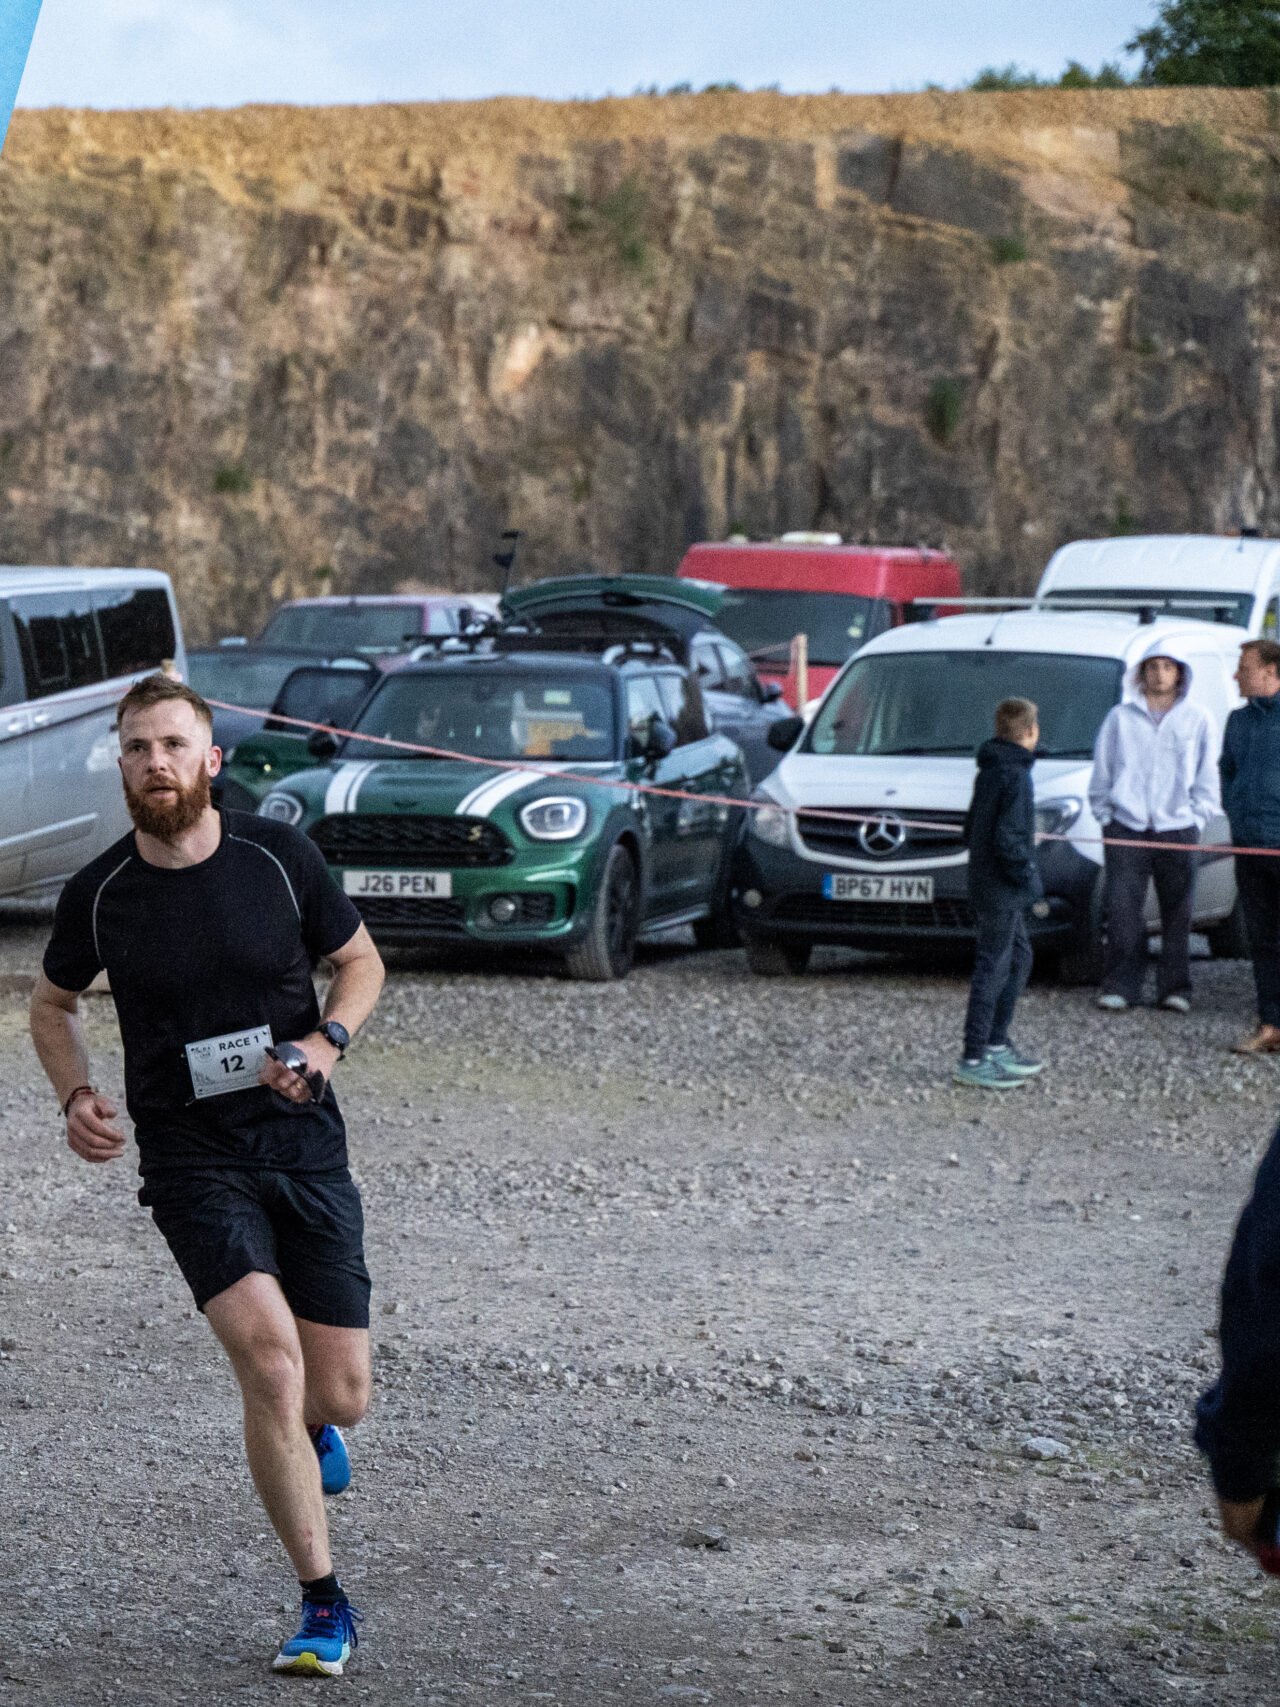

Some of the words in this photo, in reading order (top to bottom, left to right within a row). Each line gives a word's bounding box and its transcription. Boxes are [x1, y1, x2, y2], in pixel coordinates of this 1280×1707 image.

[358, 874, 394, 893] J26
[399, 875, 436, 893] PEN
[835, 877, 884, 898] BP67
[889, 879, 930, 898] HVN
[219, 1037, 251, 1051] RACE
[254, 1035, 259, 1043] 1
[221, 1055, 245, 1073] 12
